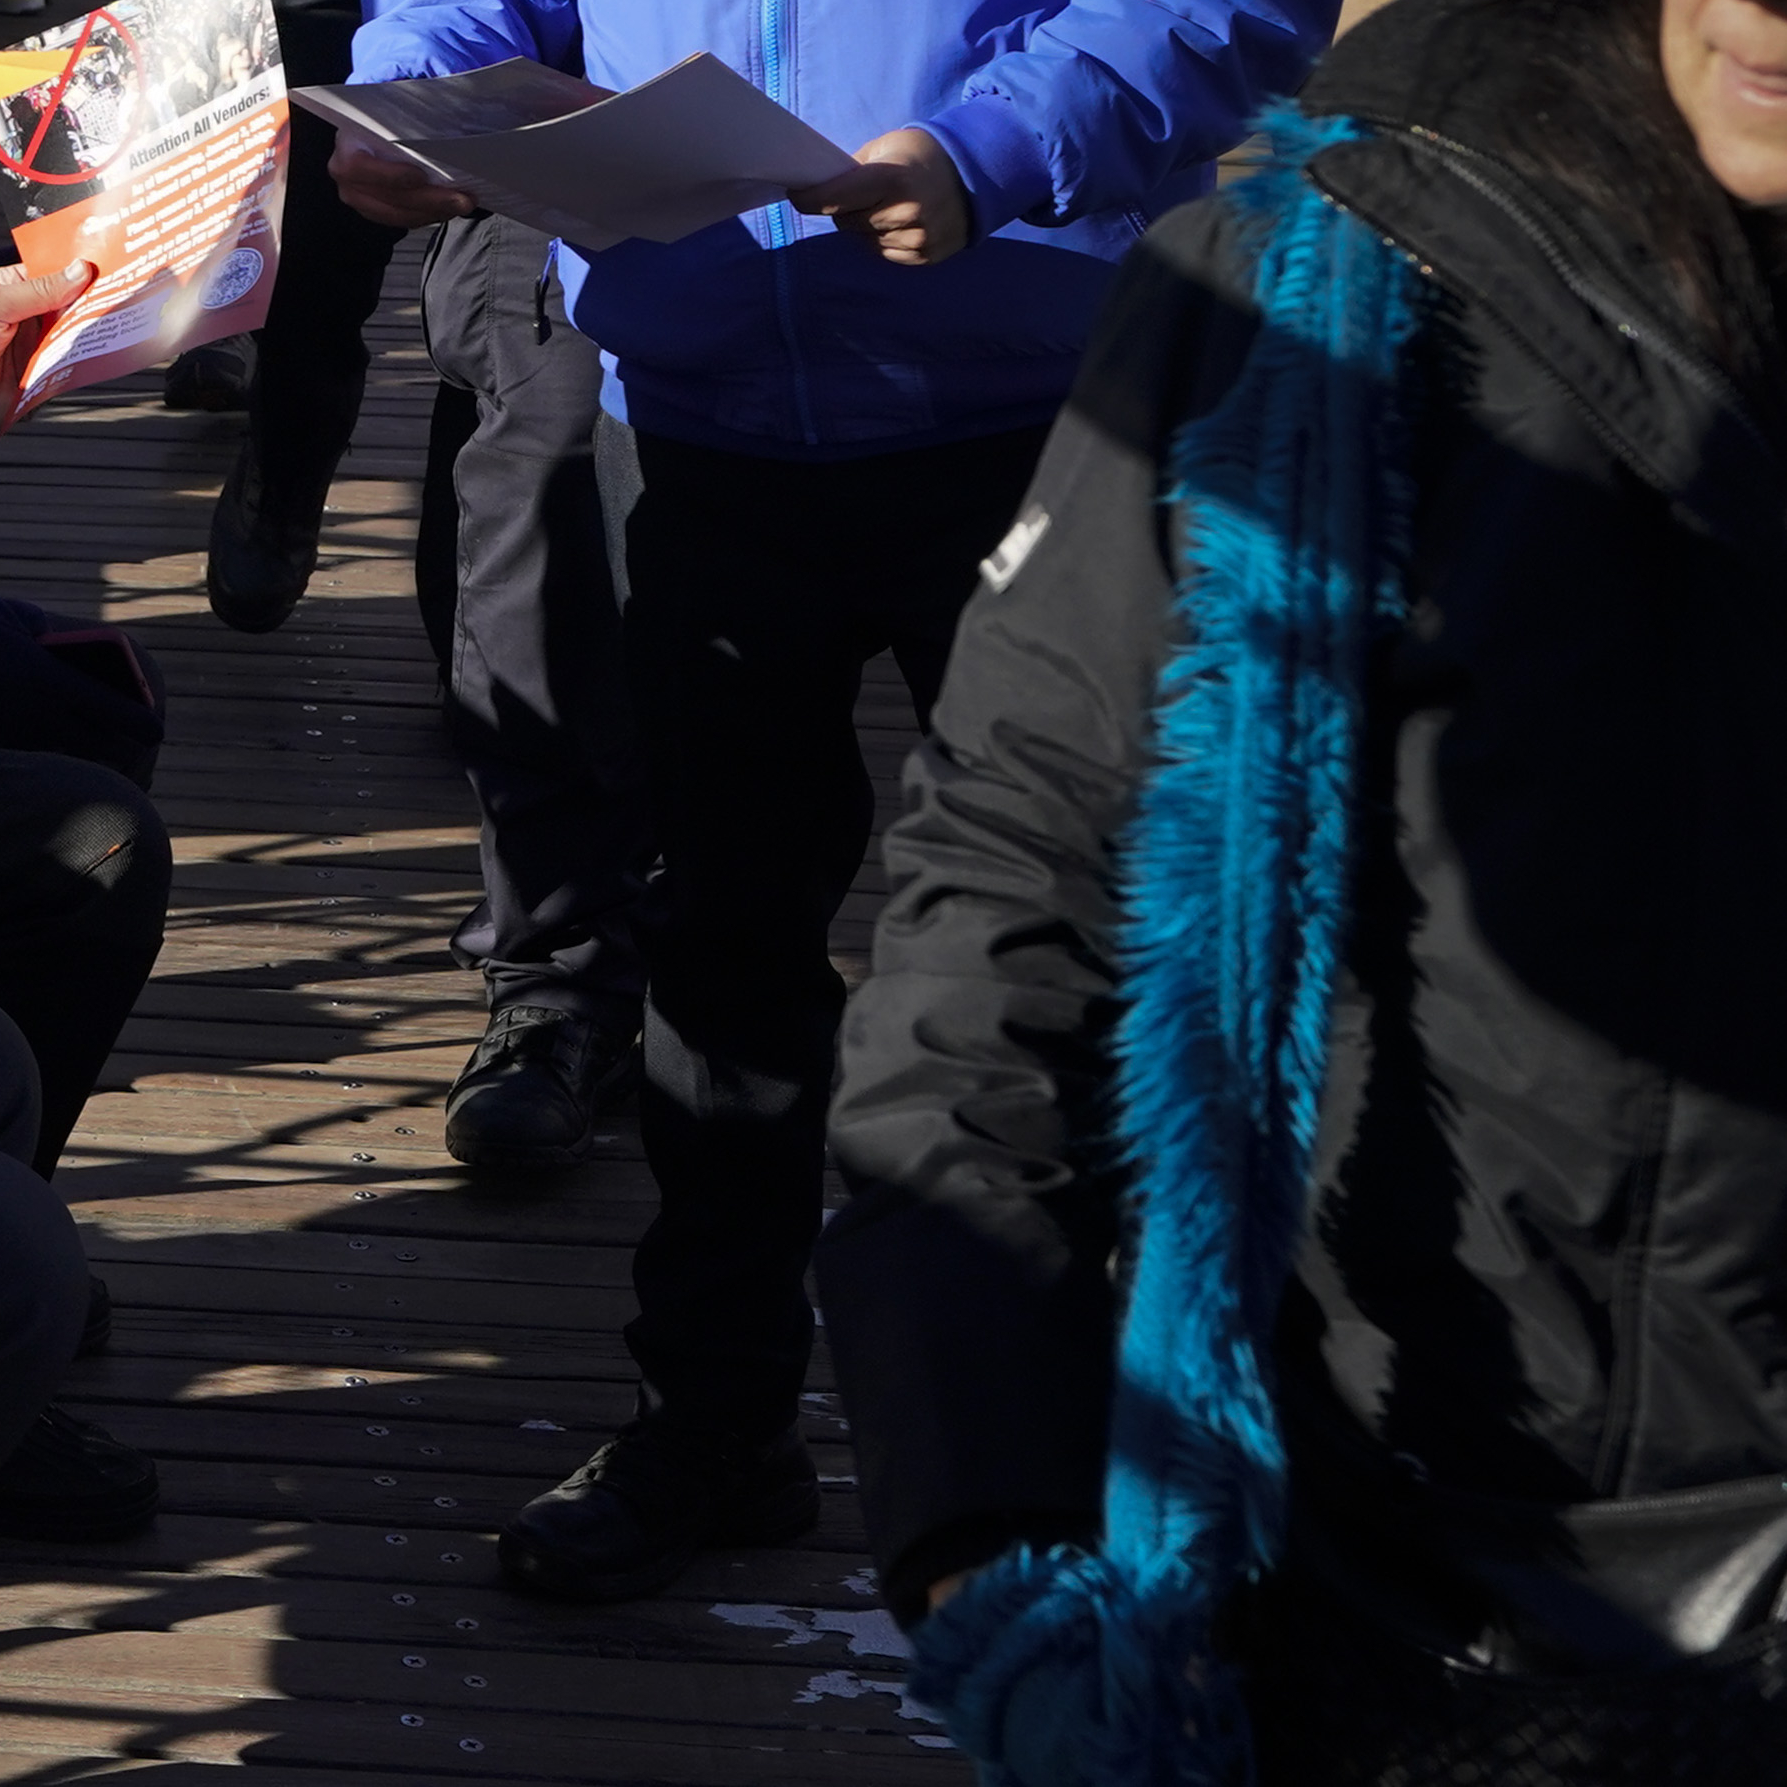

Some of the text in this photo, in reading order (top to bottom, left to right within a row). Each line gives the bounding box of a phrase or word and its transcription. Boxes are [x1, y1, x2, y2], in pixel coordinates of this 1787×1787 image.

[129, 86, 271, 171] Attention All Vendors:
